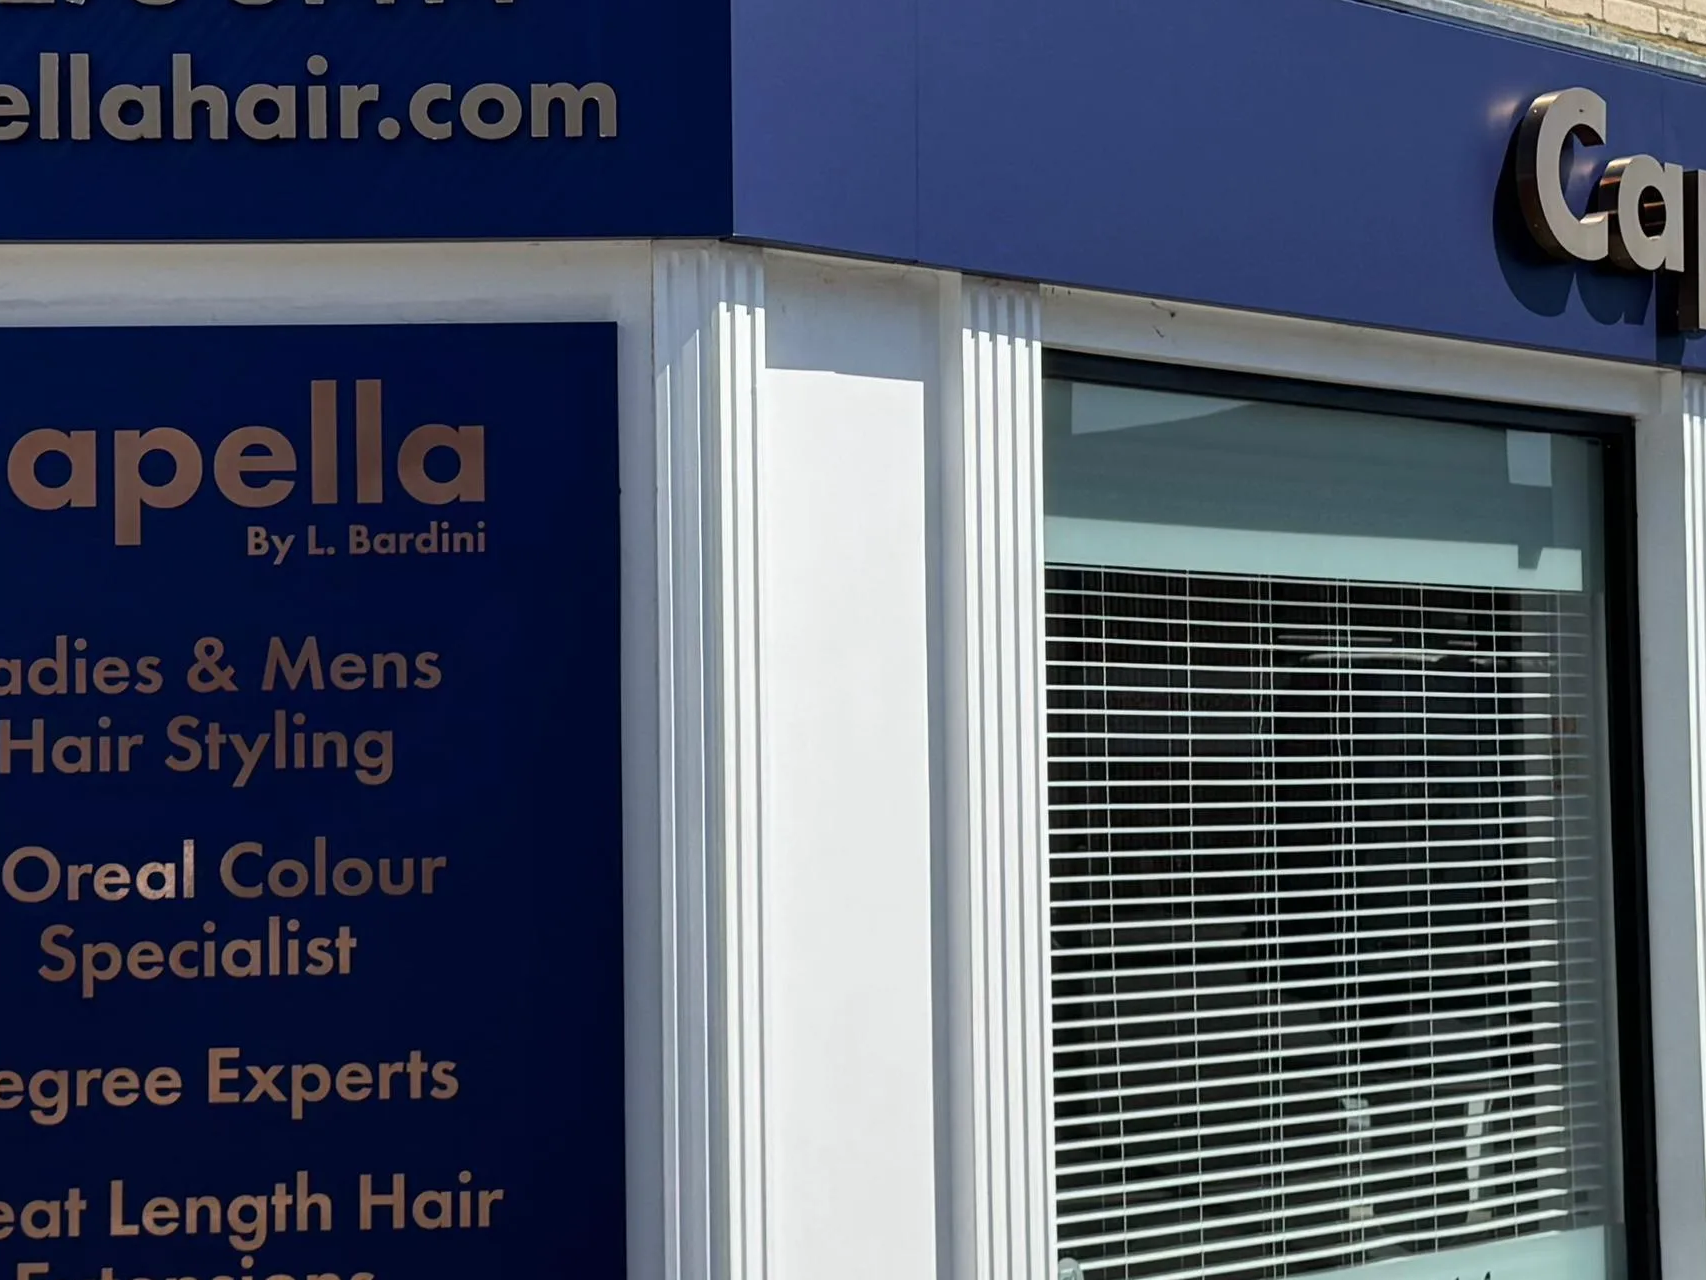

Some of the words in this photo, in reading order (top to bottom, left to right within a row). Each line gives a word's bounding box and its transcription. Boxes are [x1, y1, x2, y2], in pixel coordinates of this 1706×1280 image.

[247, 526, 294, 566] By
[308, 527, 335, 556] L.
[349, 522, 485, 555] Bardini
[187, 637, 238, 693] &
[261, 636, 442, 692] Mens
[165, 710, 394, 787] Styling
[219, 836, 447, 898] Colour
[39, 916, 357, 999] Specialist
[207, 1047, 460, 1120] Experts
[109, 1170, 332, 1252] Length
[359, 1170, 504, 1231] Hair
